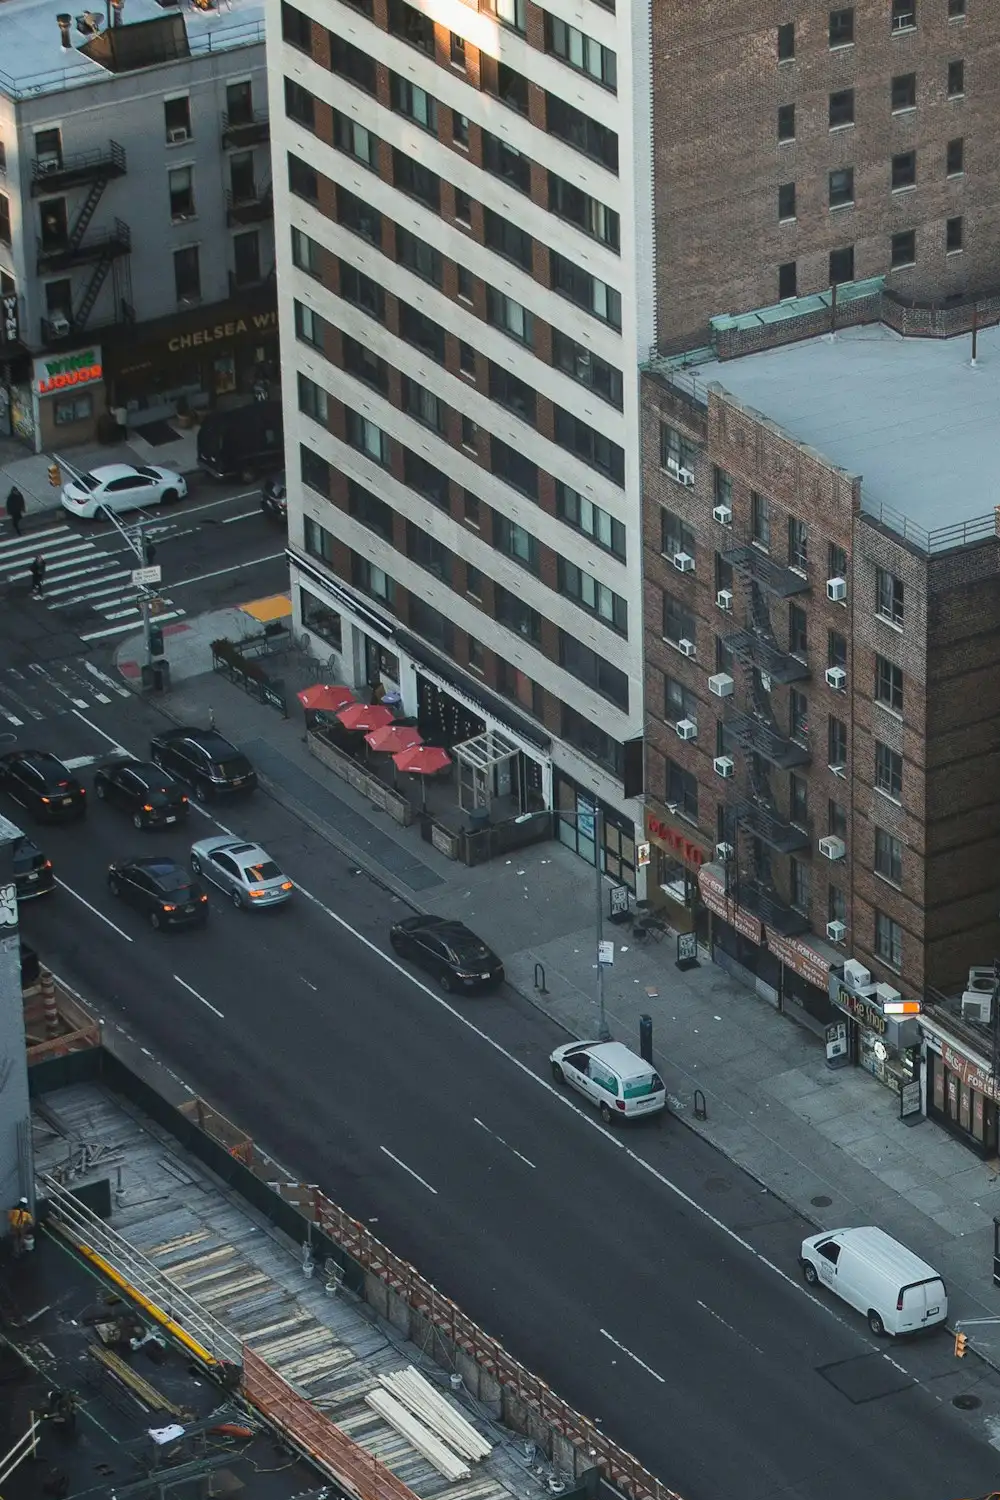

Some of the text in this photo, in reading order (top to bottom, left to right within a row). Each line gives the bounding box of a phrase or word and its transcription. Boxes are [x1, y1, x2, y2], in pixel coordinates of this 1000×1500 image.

[4, 297, 17, 340] WINE
[168, 319, 248, 352] CHELSEA
[253, 311, 279, 328] WI
[39, 364, 103, 394] LIQUOR
[45, 350, 95, 376] WINE
